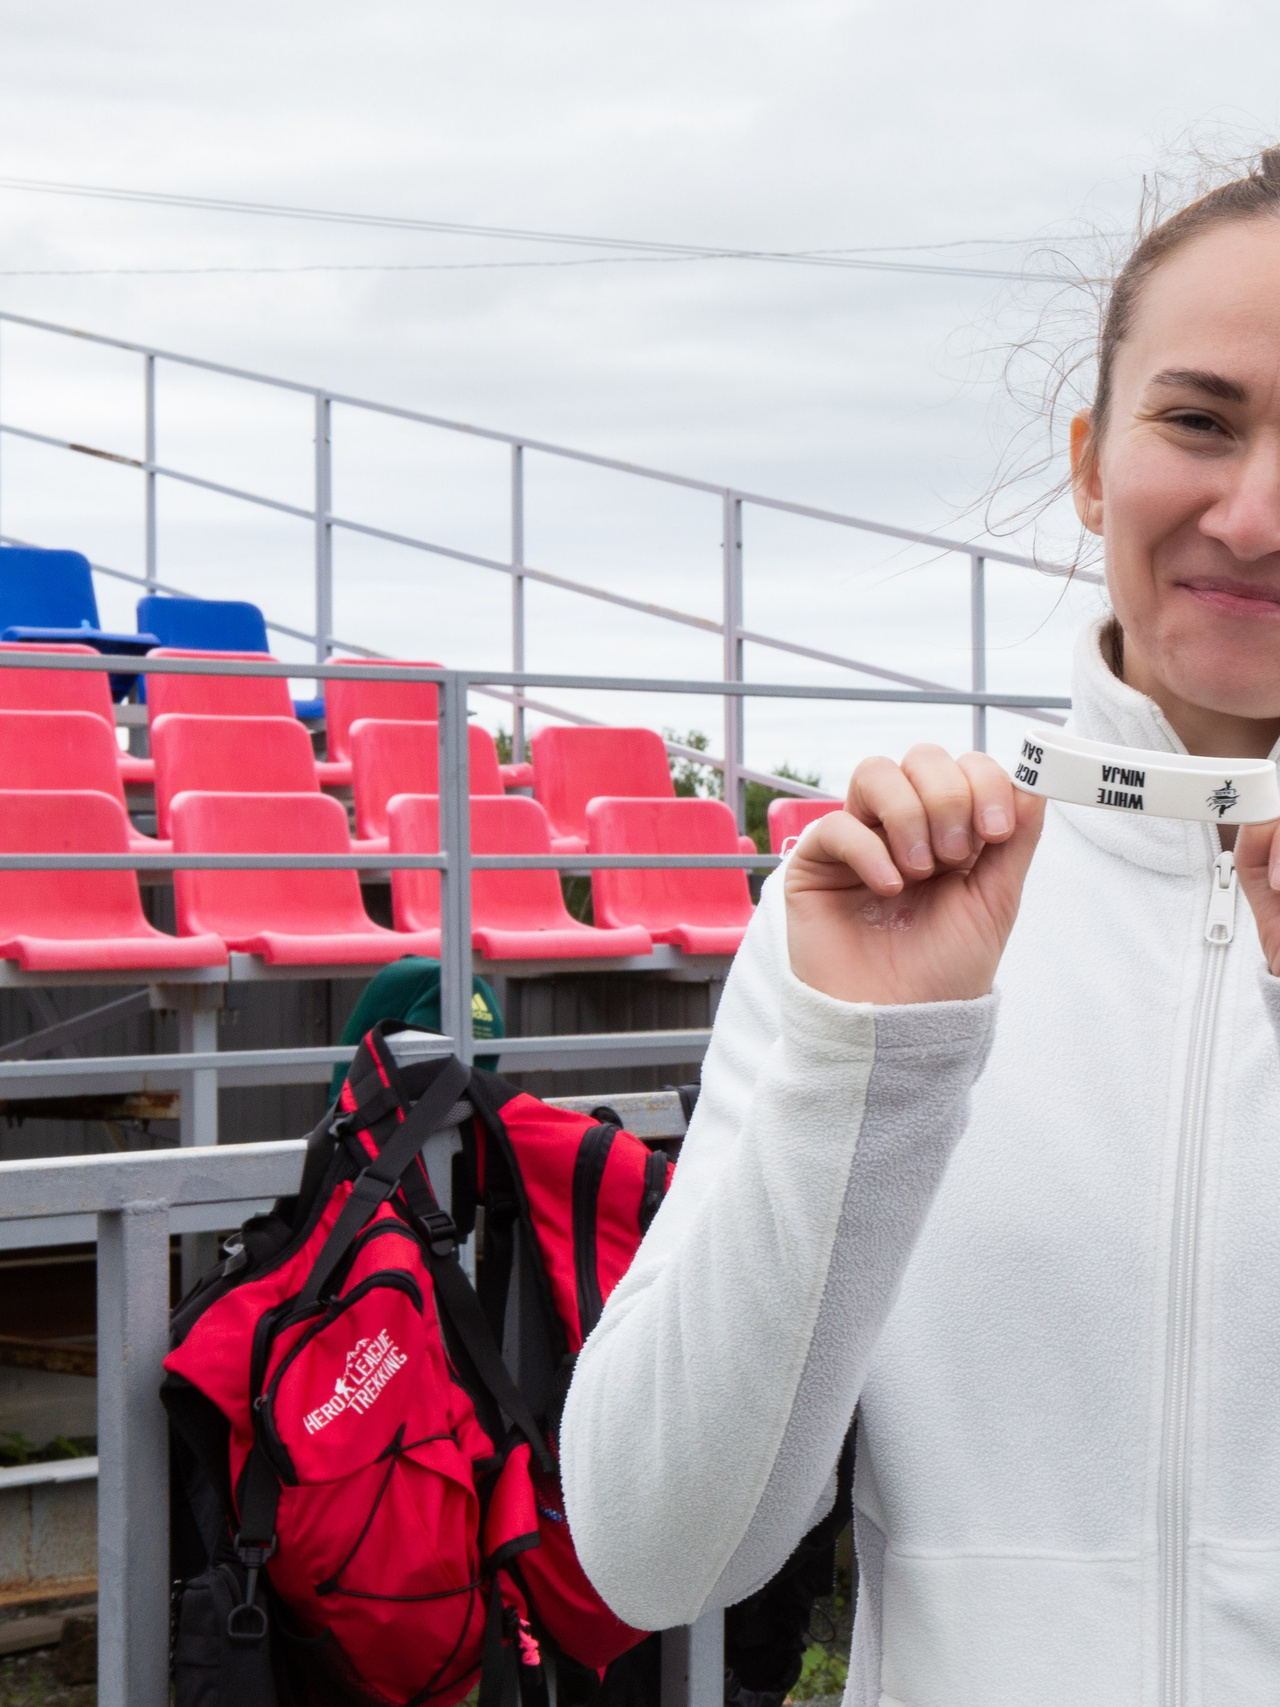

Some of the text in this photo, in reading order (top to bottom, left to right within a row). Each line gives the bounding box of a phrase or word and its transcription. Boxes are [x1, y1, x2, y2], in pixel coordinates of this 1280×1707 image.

[1097, 788, 1144, 809] WHITE
[1102, 765, 1145, 787] NINJA
[303, 1328, 393, 1434] HERO LEAGUE
[347, 1346, 408, 1414] TREKKING
